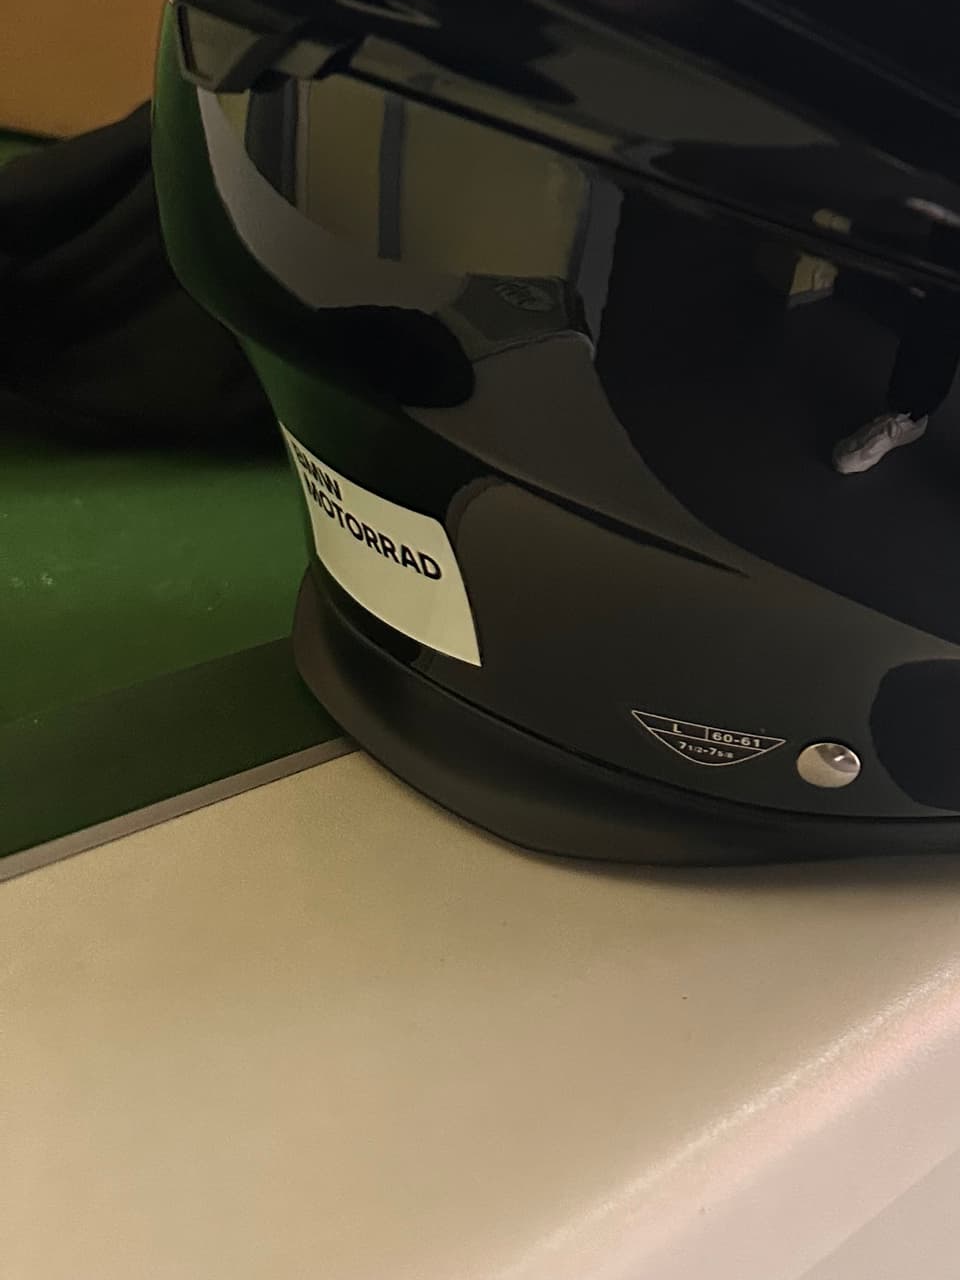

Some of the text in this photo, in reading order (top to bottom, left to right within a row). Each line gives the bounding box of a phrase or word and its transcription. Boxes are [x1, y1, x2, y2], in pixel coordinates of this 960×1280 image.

[303, 471, 442, 581] MOTORRAD
[672, 723, 760, 748] L 60-61
